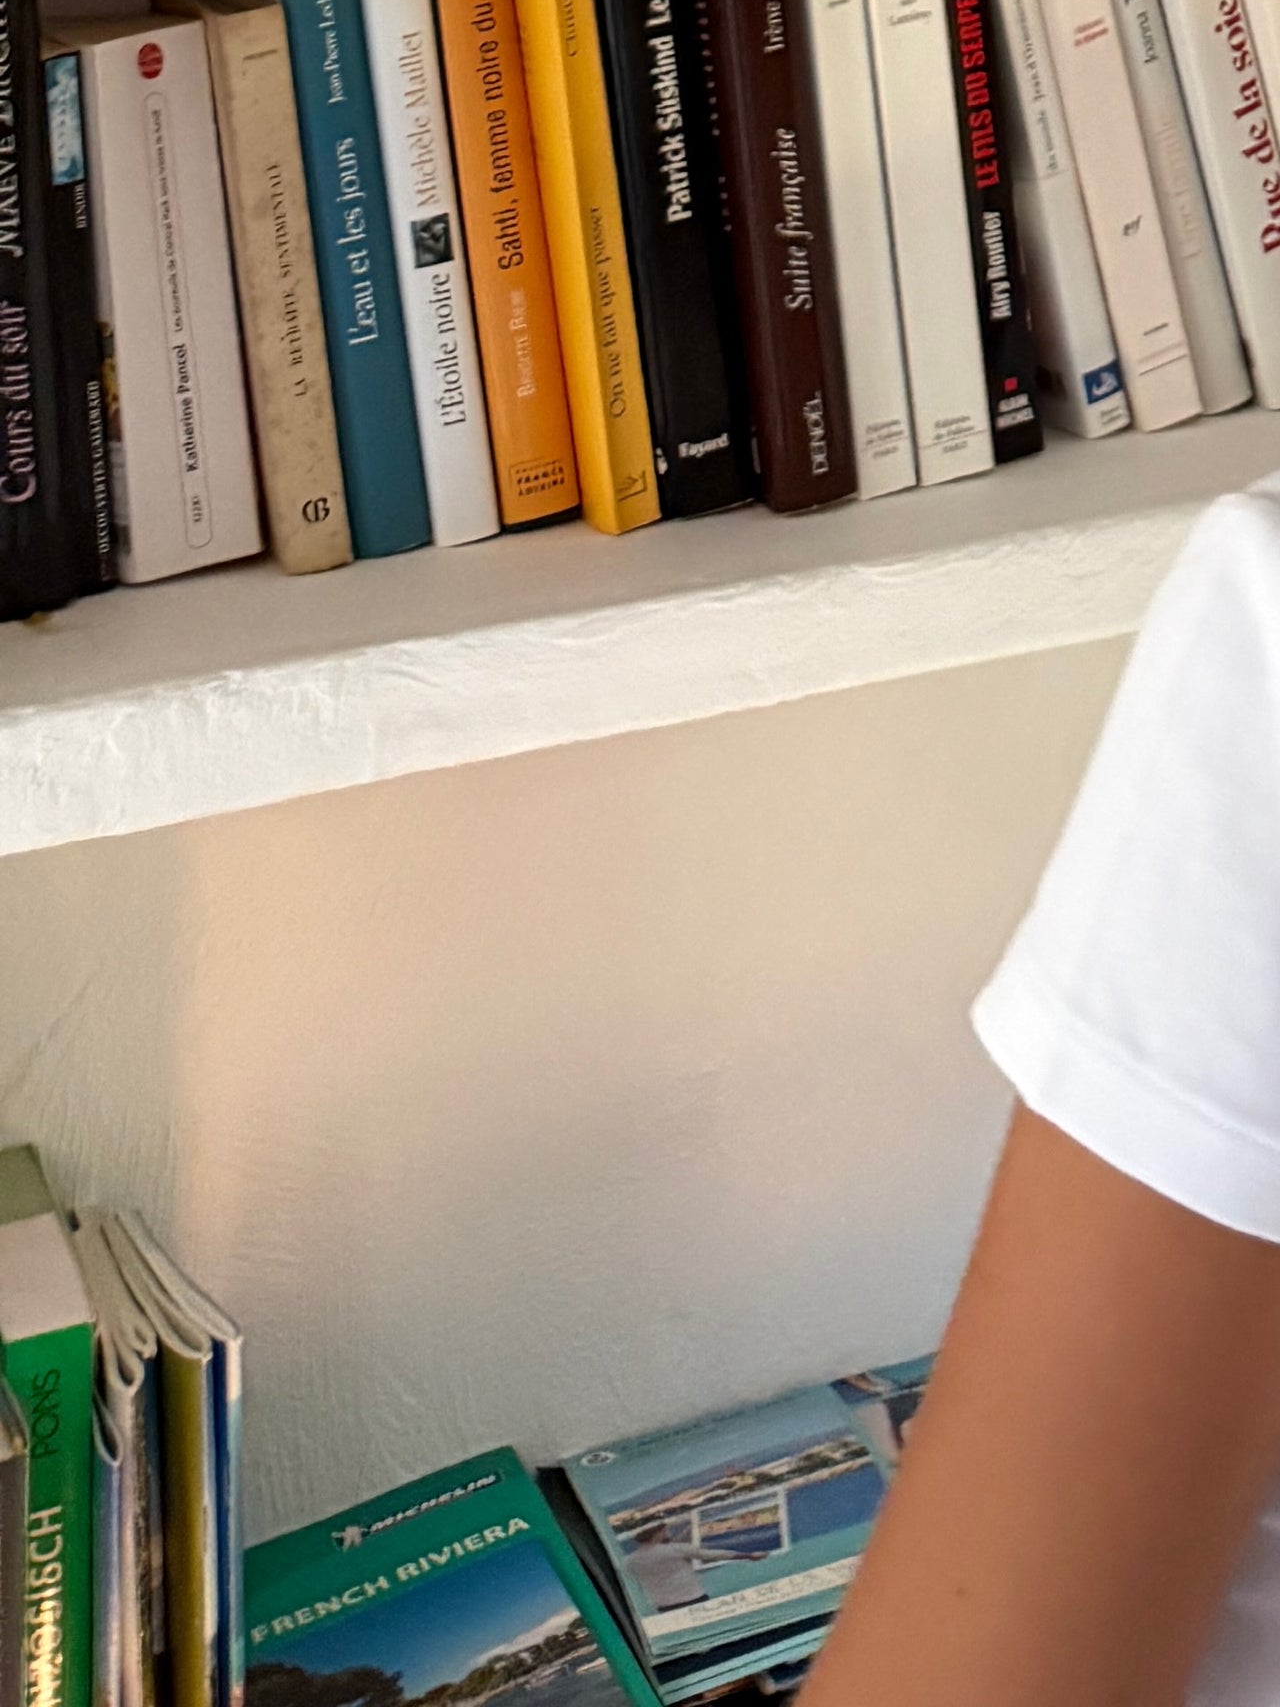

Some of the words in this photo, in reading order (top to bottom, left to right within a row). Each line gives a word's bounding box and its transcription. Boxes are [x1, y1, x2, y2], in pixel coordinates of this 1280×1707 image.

[471, 1, 496, 32] du
[761, 2, 787, 53] Irène
[1135, 10, 1159, 64] Joanna
[319, 30, 348, 104] Jean-Pierre
[398, 29, 434, 108] Maillet
[475, 40, 506, 101] noire
[650, 35, 683, 130] Süskind
[965, 72, 992, 105] DU
[1231, 76, 1263, 113] la
[405, 115, 441, 207] Michèle
[484, 109, 517, 192] femme
[970, 111, 998, 156] FILS
[1243, 119, 1275, 164] de
[333, 137, 365, 203] jours
[659, 134, 692, 222] Patrick
[772, 127, 814, 239] française
[977, 162, 1001, 186] LE
[340, 208, 365, 244] les
[343, 248, 368, 274] et
[782, 245, 814, 310] Suite
[0, 299, 28, 354] soir
[344, 280, 381, 345] L'eau
[428, 272, 456, 334] noire
[2, 363, 31, 400] du
[171, 344, 194, 392] Pancol
[434, 341, 468, 425] L'Étoile
[1, 406, 39, 503] Cours
[175, 396, 200, 473] Katherine
[805, 391, 829, 473] DENOËL
[30, 1369, 61, 1458] PONS
[251, 1574, 390, 1643] FRENCH
[396, 1516, 530, 1583] RIVIERA
